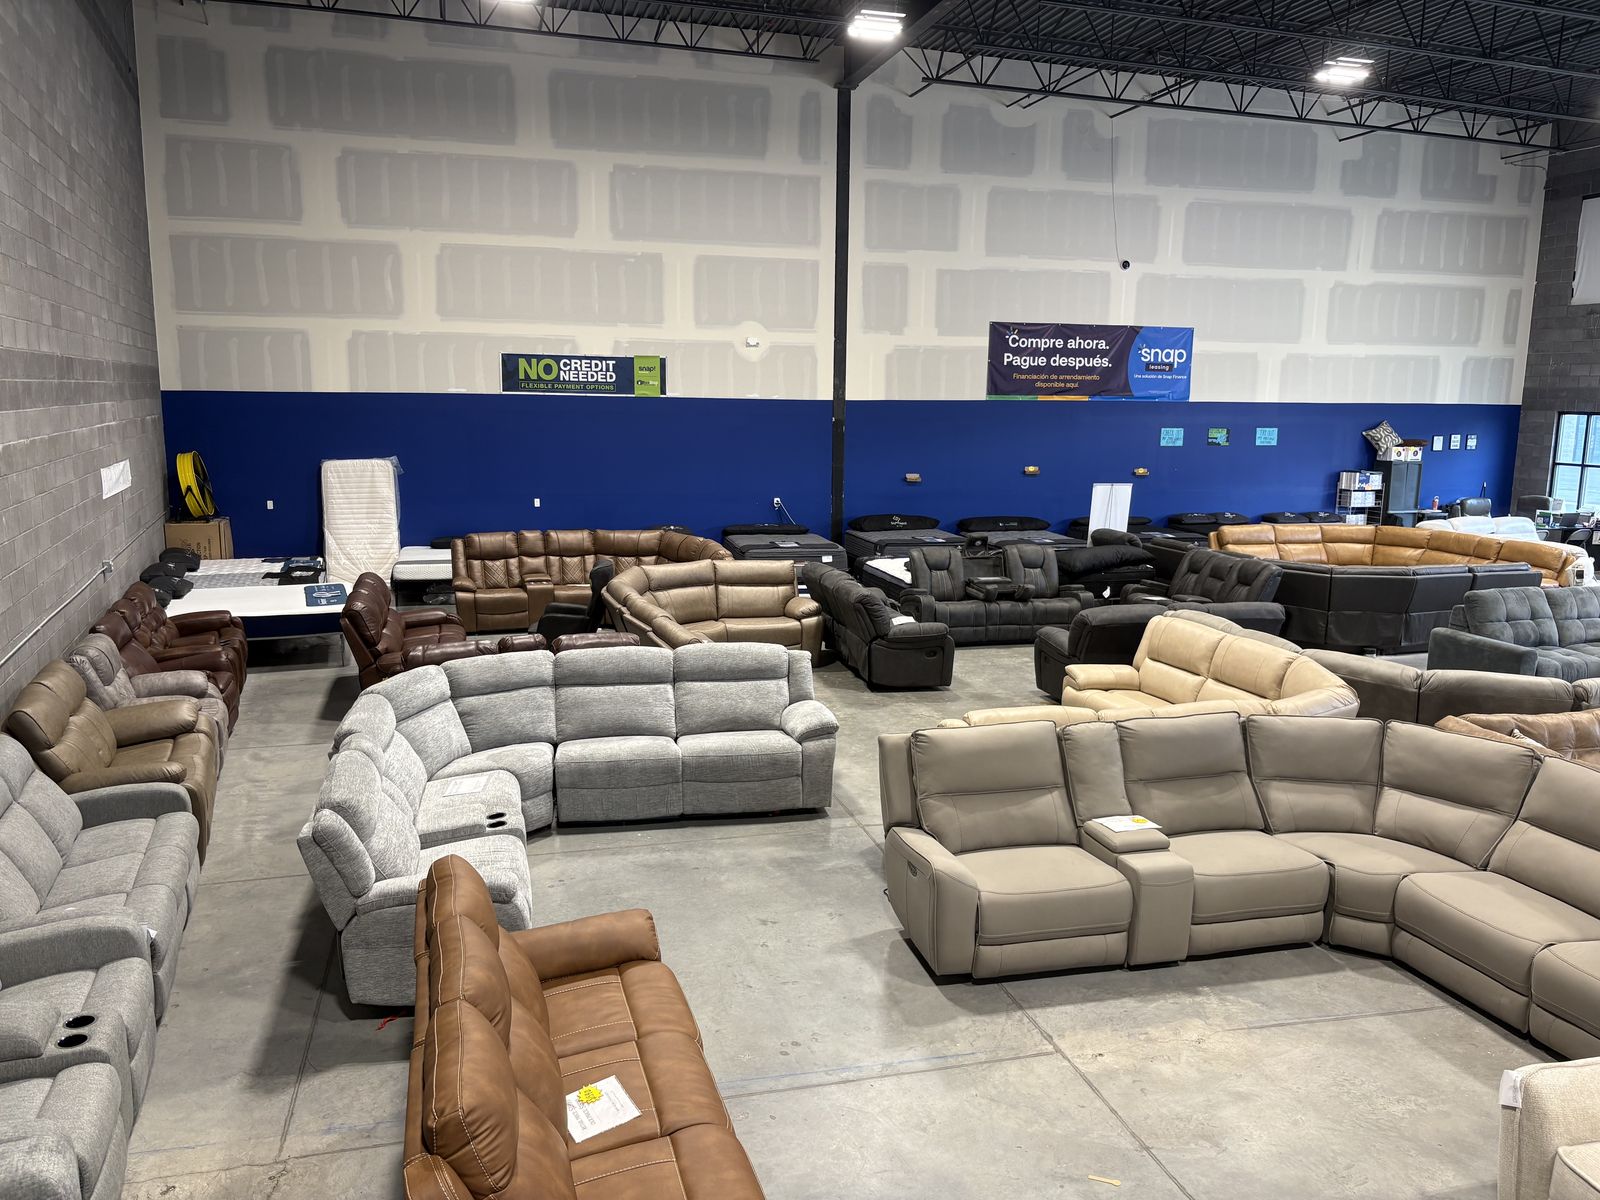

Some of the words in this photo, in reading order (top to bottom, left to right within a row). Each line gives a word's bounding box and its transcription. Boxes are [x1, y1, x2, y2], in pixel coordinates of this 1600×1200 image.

[1008, 334, 1064, 351] Compre
[1067, 336, 1110, 350] ahora.
[559, 358, 616, 372] CREDIT
[1003, 352, 1047, 369] Pague
[1050, 353, 1112, 370] después.
[1140, 348, 1187, 368] snap
[518, 357, 559, 381] NO
[1148, 364, 1170, 372] leasing
[559, 371, 616, 383] NEEDED
[1012, 372, 1049, 380] Financiación
[1058, 373, 1101, 381] arrendamiento
[1034, 381, 1065, 389] disponible
